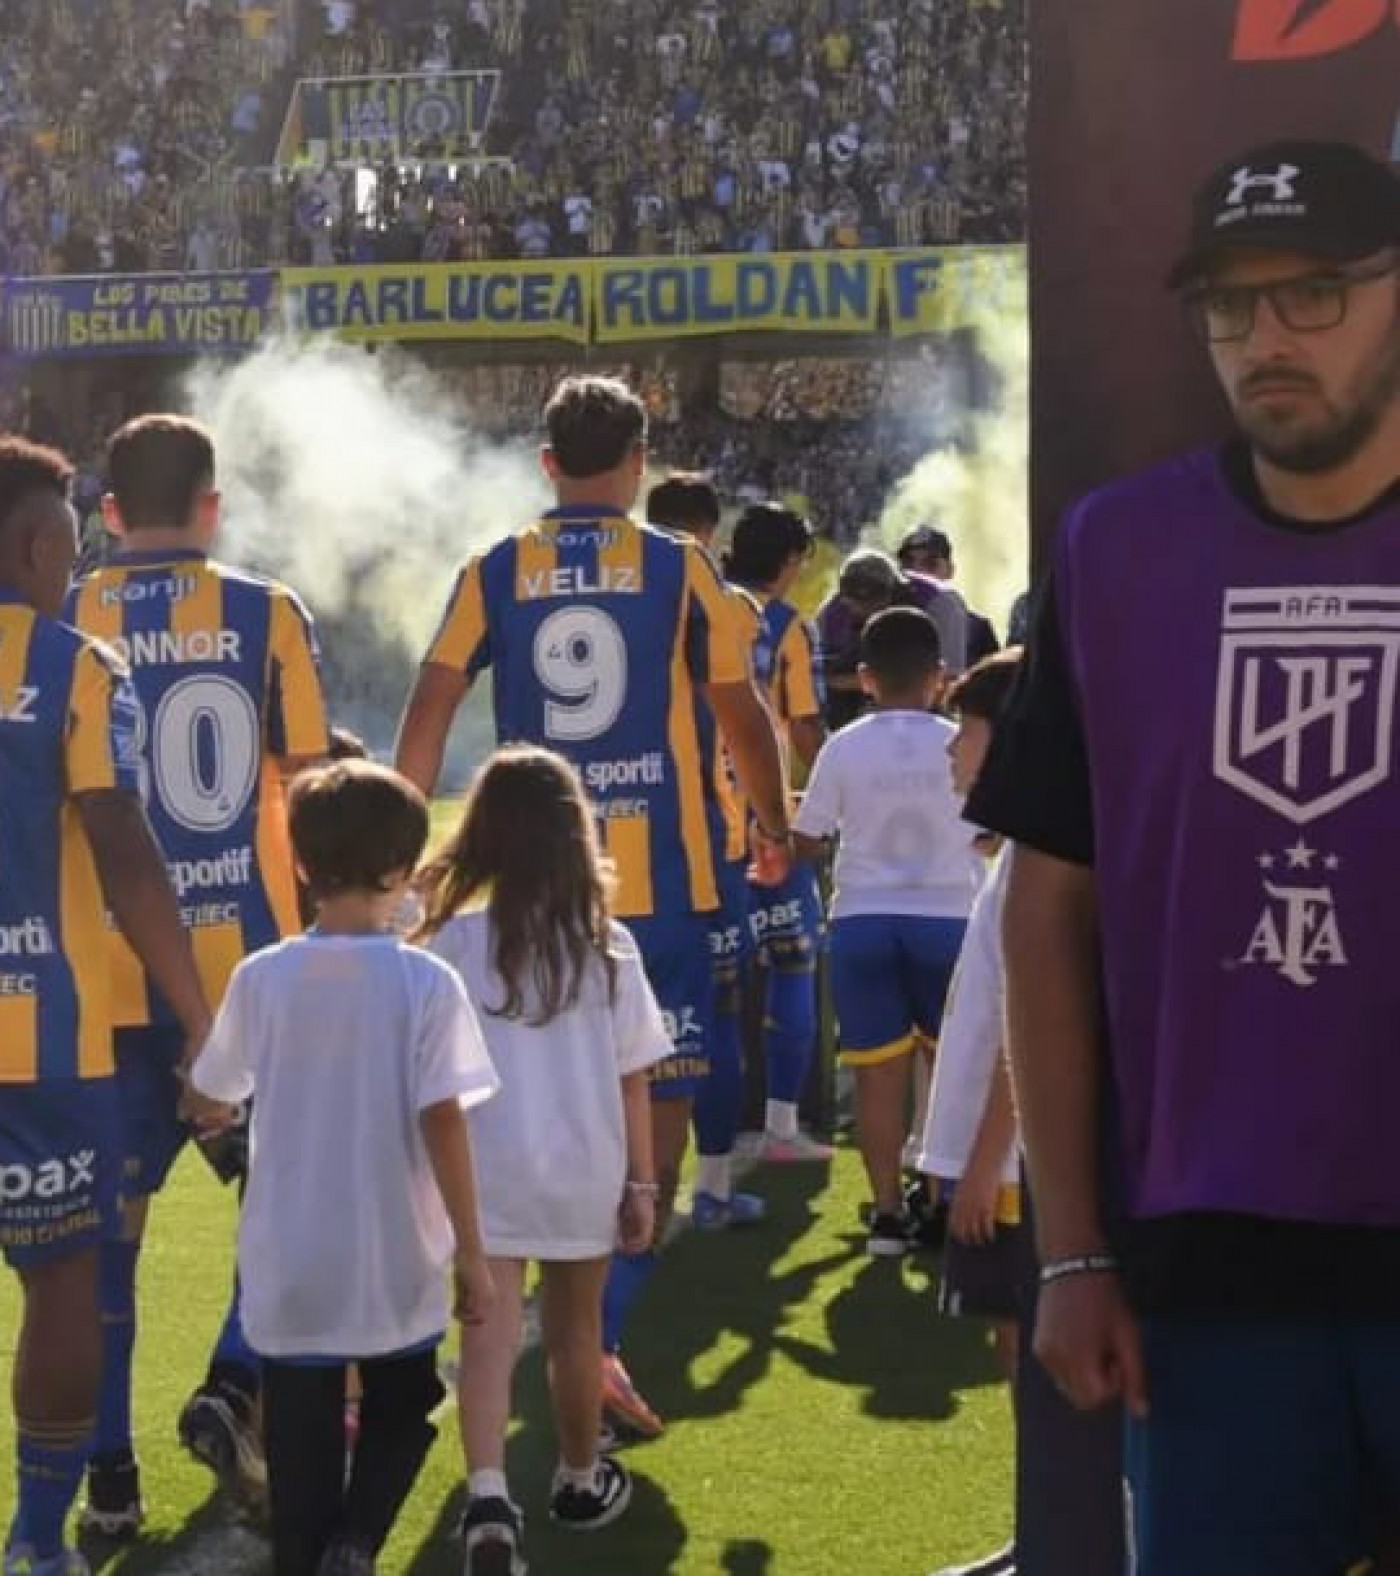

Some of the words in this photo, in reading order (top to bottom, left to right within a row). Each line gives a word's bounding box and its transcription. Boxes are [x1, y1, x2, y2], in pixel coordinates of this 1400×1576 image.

[602, 256, 870, 328] ROLDAN
[65, 307, 168, 346] BELLA
[174, 303, 262, 343] VISTA
[523, 565, 635, 598] VELIZ
[1284, 596, 1343, 619] AFA
[532, 603, 628, 741] 9
